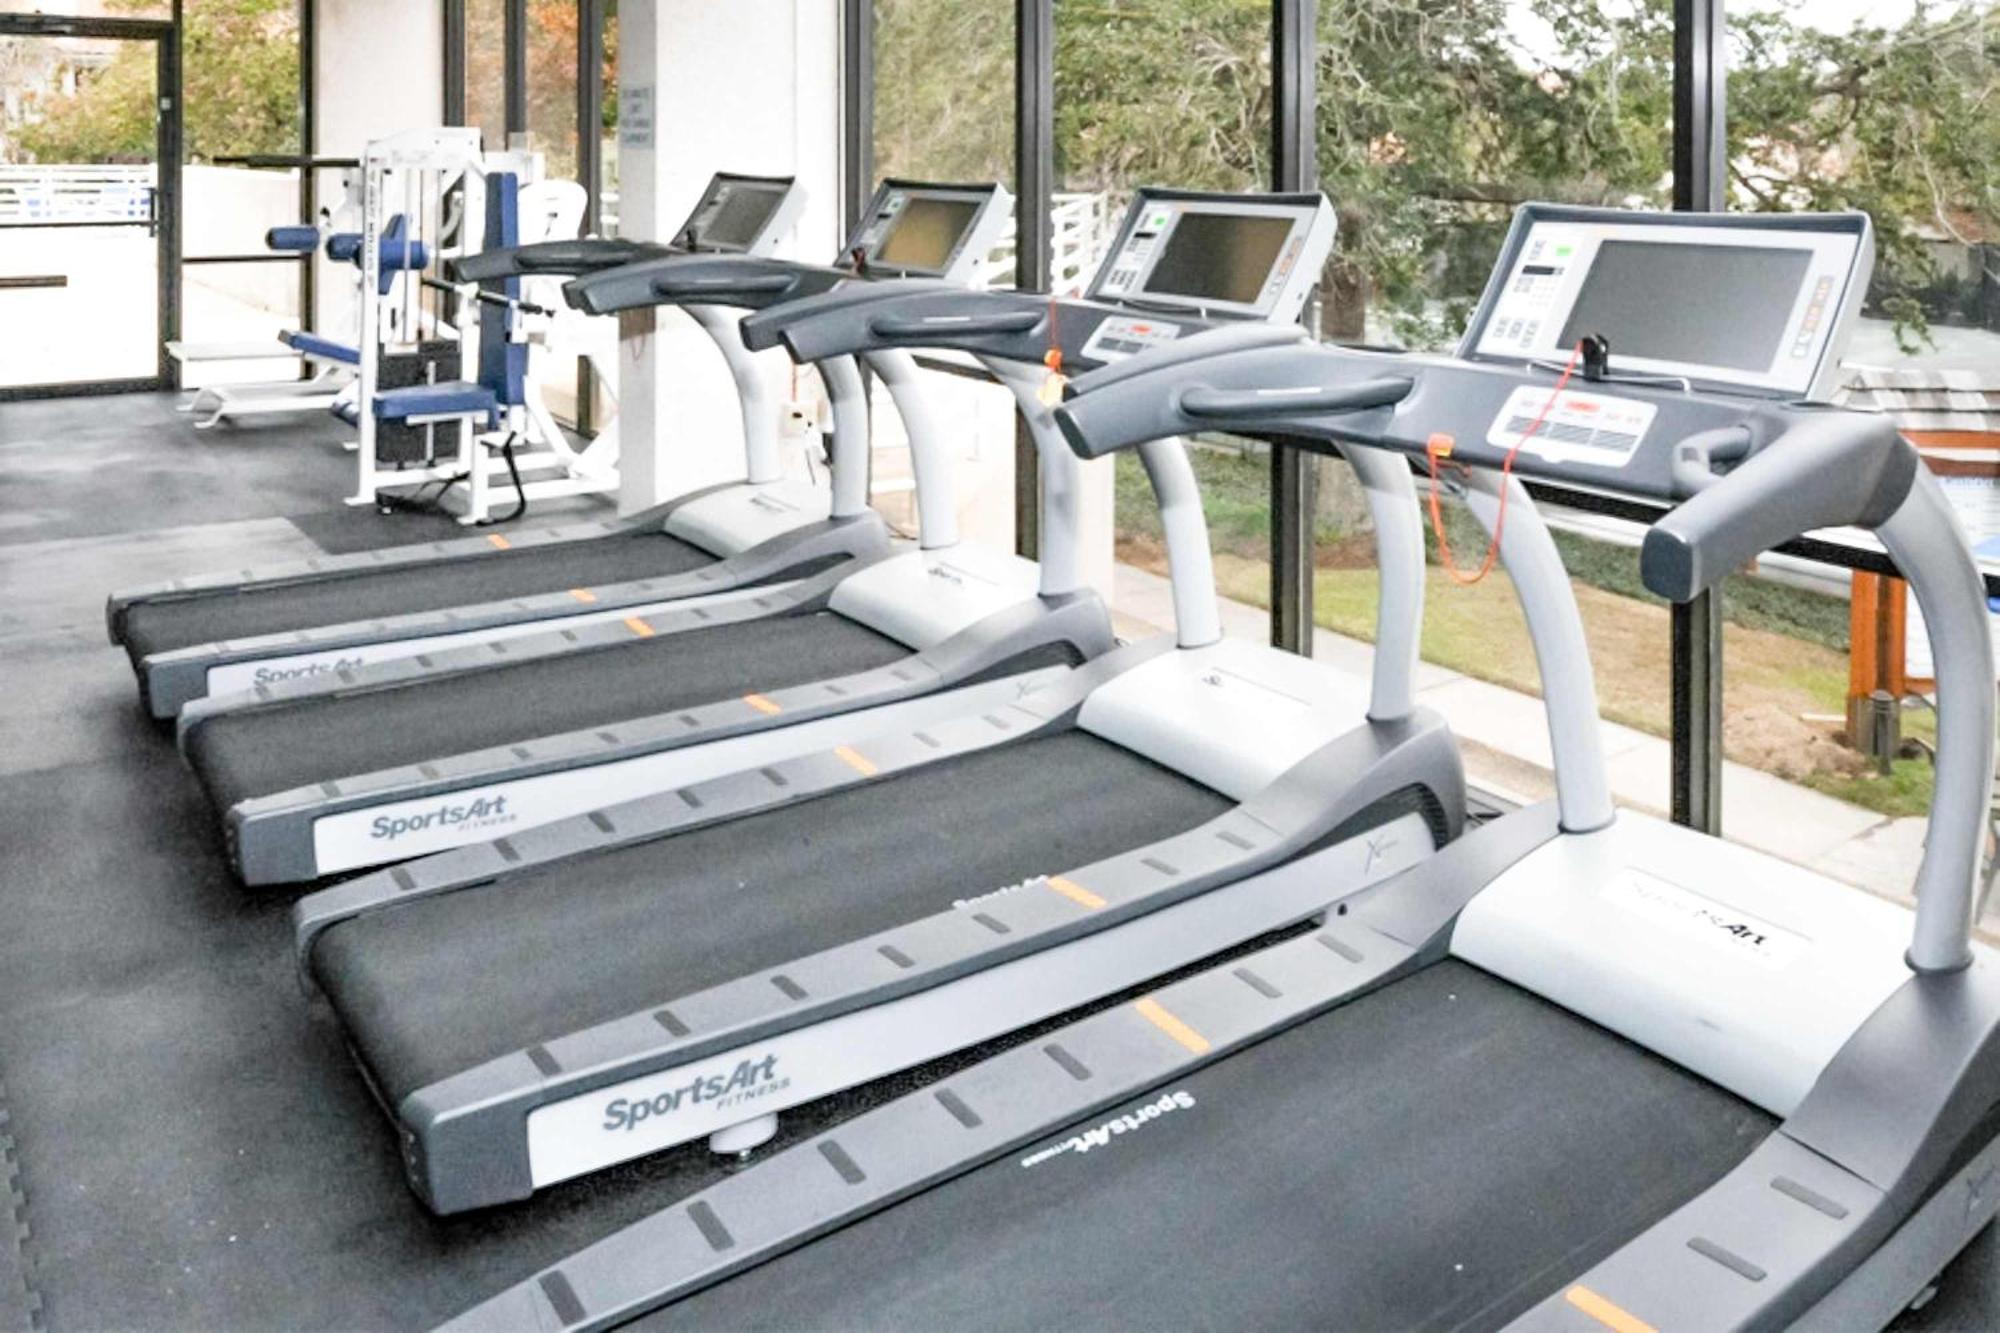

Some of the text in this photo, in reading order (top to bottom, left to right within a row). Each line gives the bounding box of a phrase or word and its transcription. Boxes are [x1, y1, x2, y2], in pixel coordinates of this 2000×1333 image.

[371, 795, 507, 840] SportsArt
[603, 1053, 778, 1131] SportsArt
[717, 1077, 791, 1111] FITNESS
[1073, 1090, 1197, 1154] SportsArt
